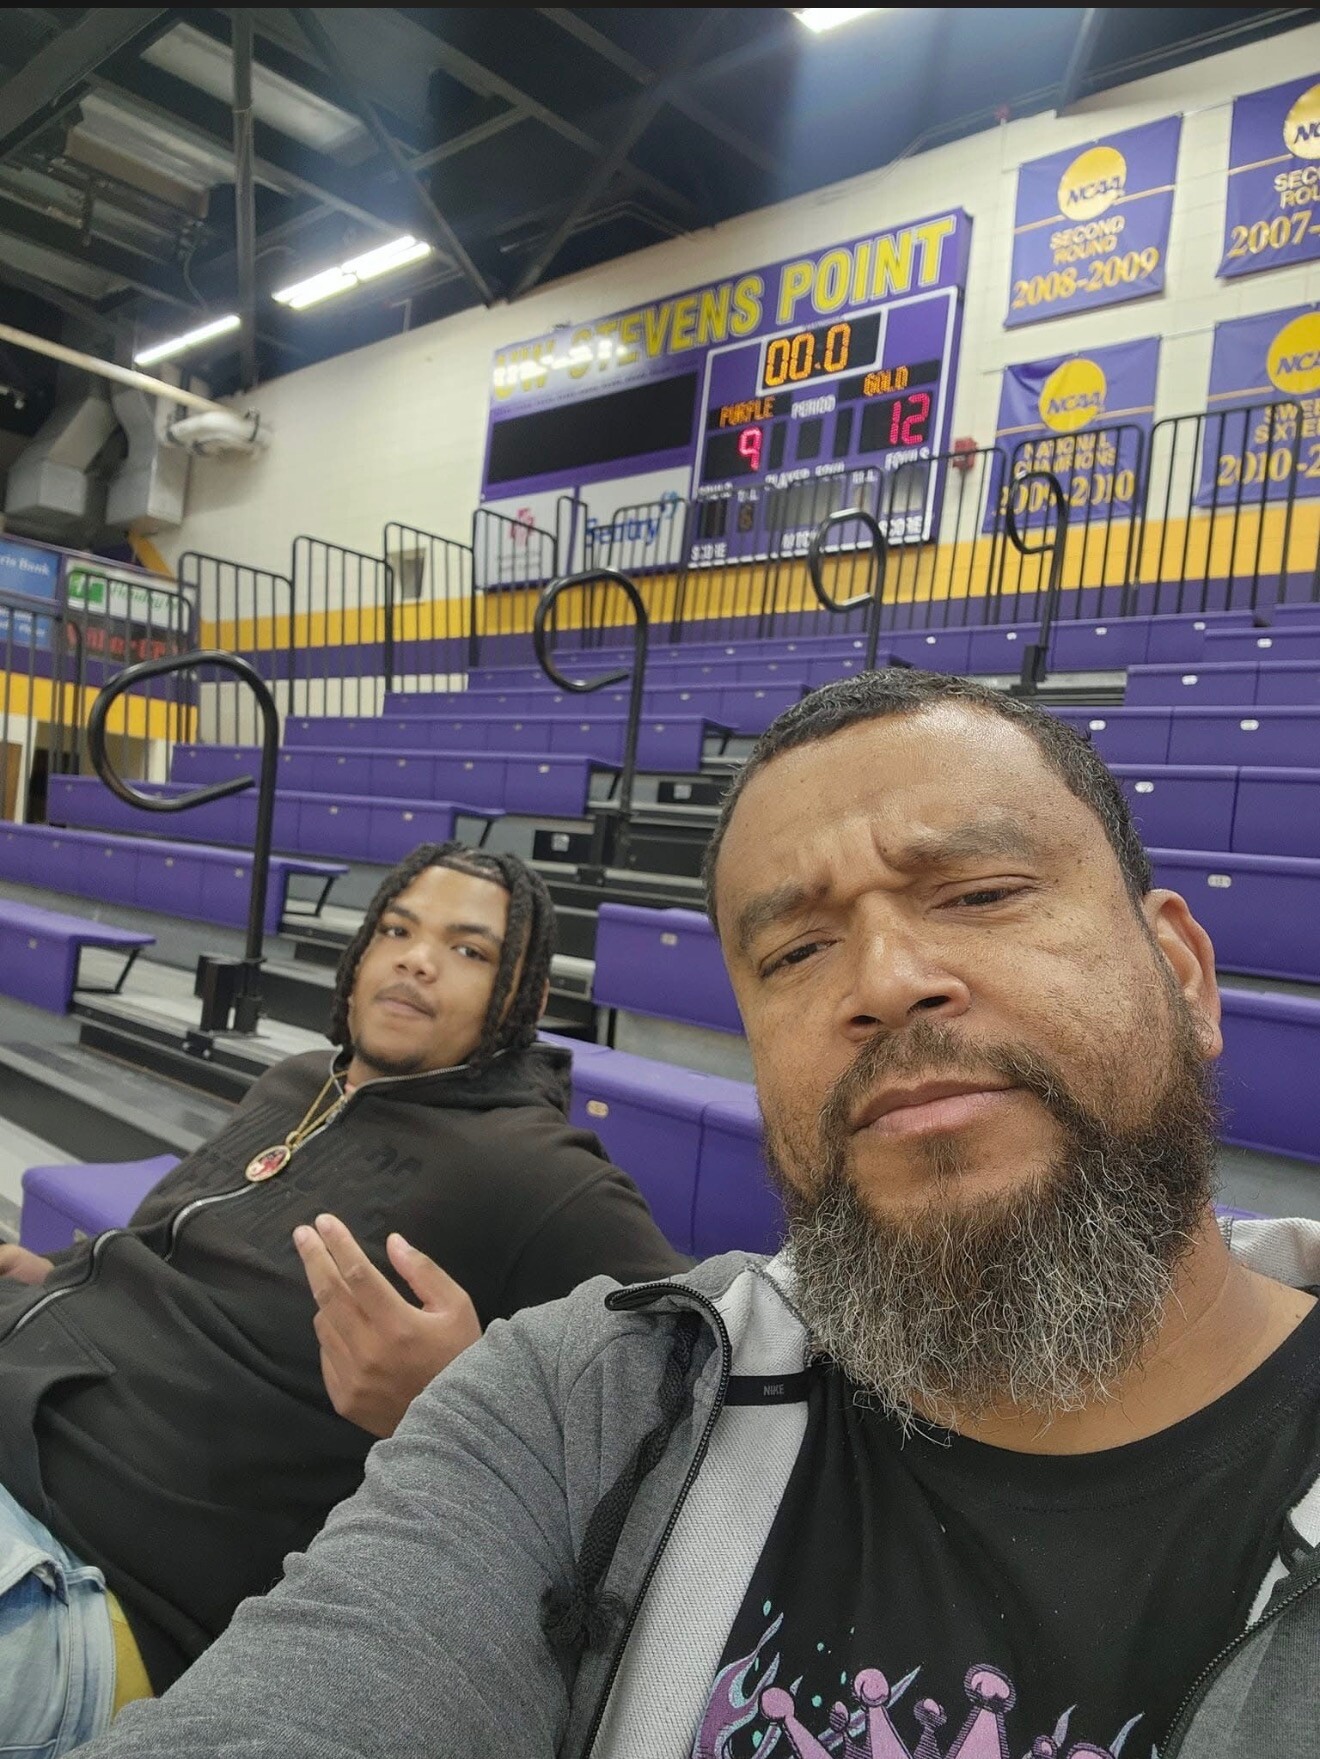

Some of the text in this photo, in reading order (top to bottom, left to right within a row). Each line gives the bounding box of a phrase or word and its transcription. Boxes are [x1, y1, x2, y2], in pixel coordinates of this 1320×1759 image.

[1066, 176, 1121, 207] NCAA
[1273, 165, 1320, 192] SEC
[1050, 215, 1125, 250] SECOND
[1053, 234, 1117, 265] ROUND
[777, 215, 957, 326] POINT
[1011, 246, 1160, 310] 2008-2009
[765, 322, 851, 387] 00.0
[864, 365, 909, 396] GOLD
[719, 396, 776, 428] PURPLE
[791, 394, 836, 419] PERIOD
[889, 392, 931, 446] 12
[1047, 392, 1101, 415] NCAA
[738, 426, 764, 471] 9
[585, 516, 660, 548] Sentry
[763, 1384, 785, 1396] NIKE
